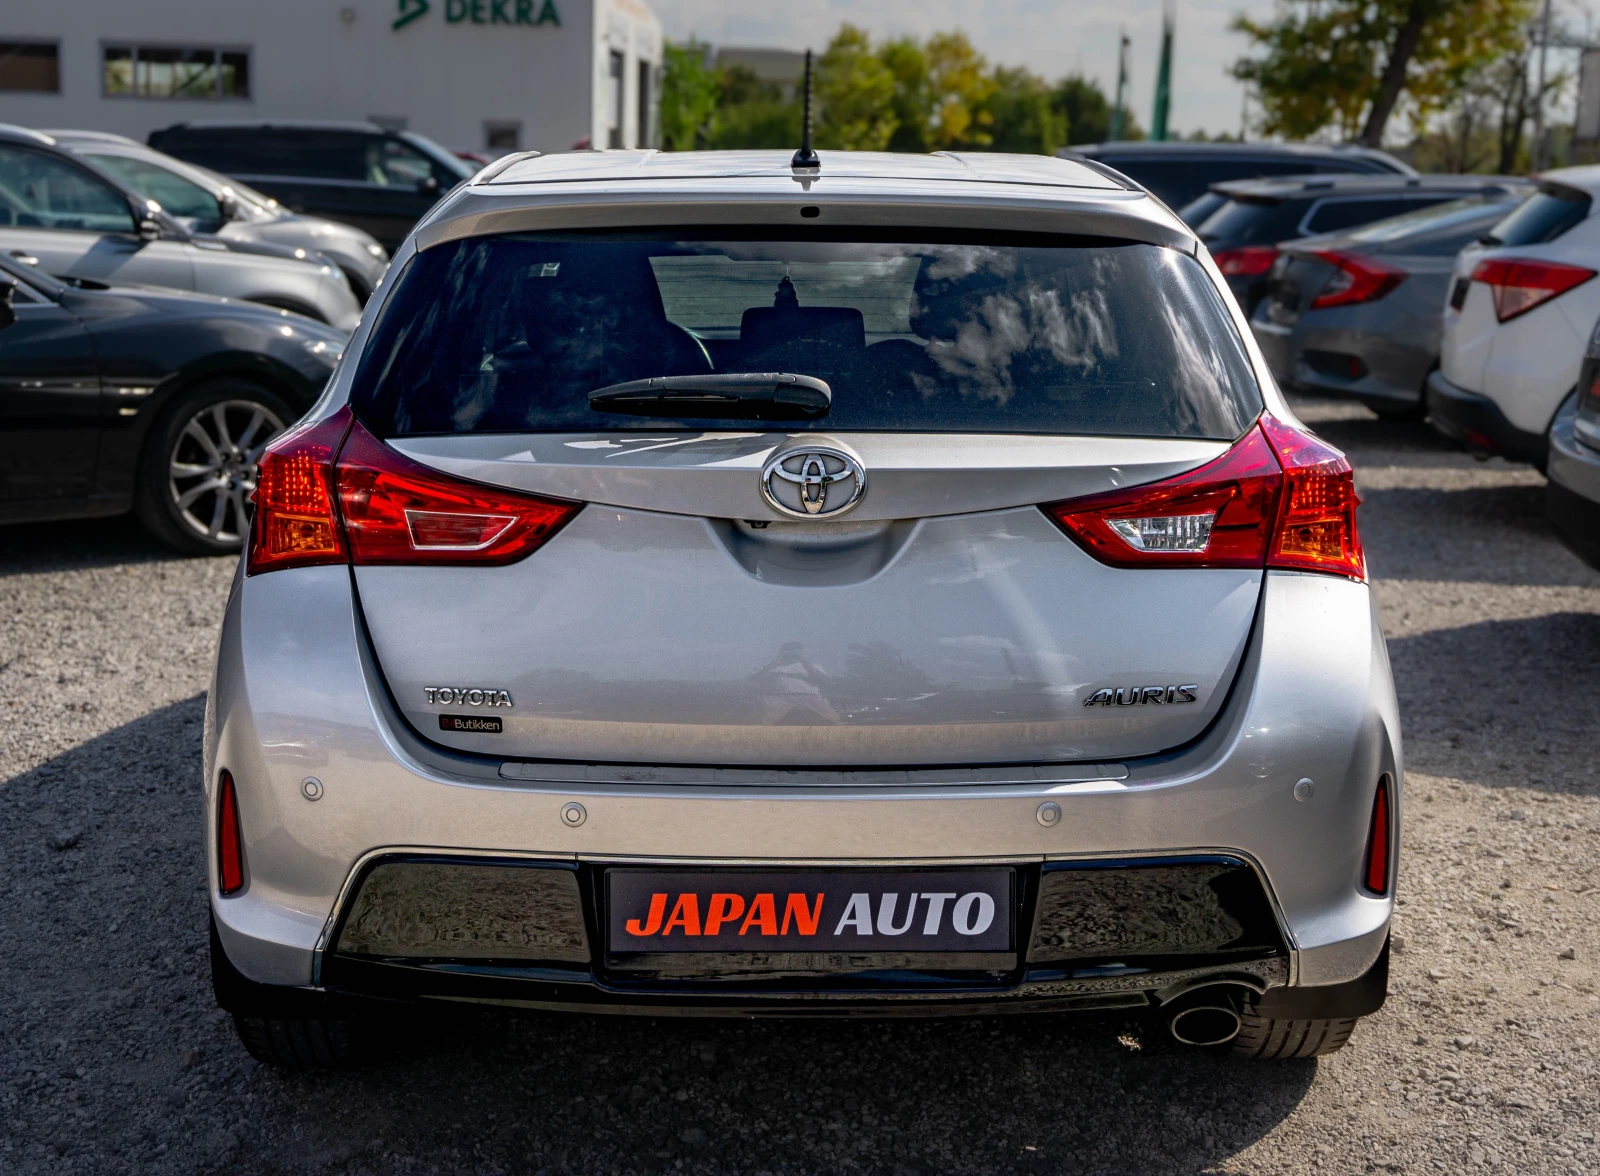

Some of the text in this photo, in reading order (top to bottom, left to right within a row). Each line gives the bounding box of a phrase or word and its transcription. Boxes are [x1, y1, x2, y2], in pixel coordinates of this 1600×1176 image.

[445, 0, 561, 26] DEKRA
[424, 687, 513, 708] TOYOTA
[1084, 683, 1198, 707] AURIS
[625, 892, 995, 936] JAPAN AUTO
